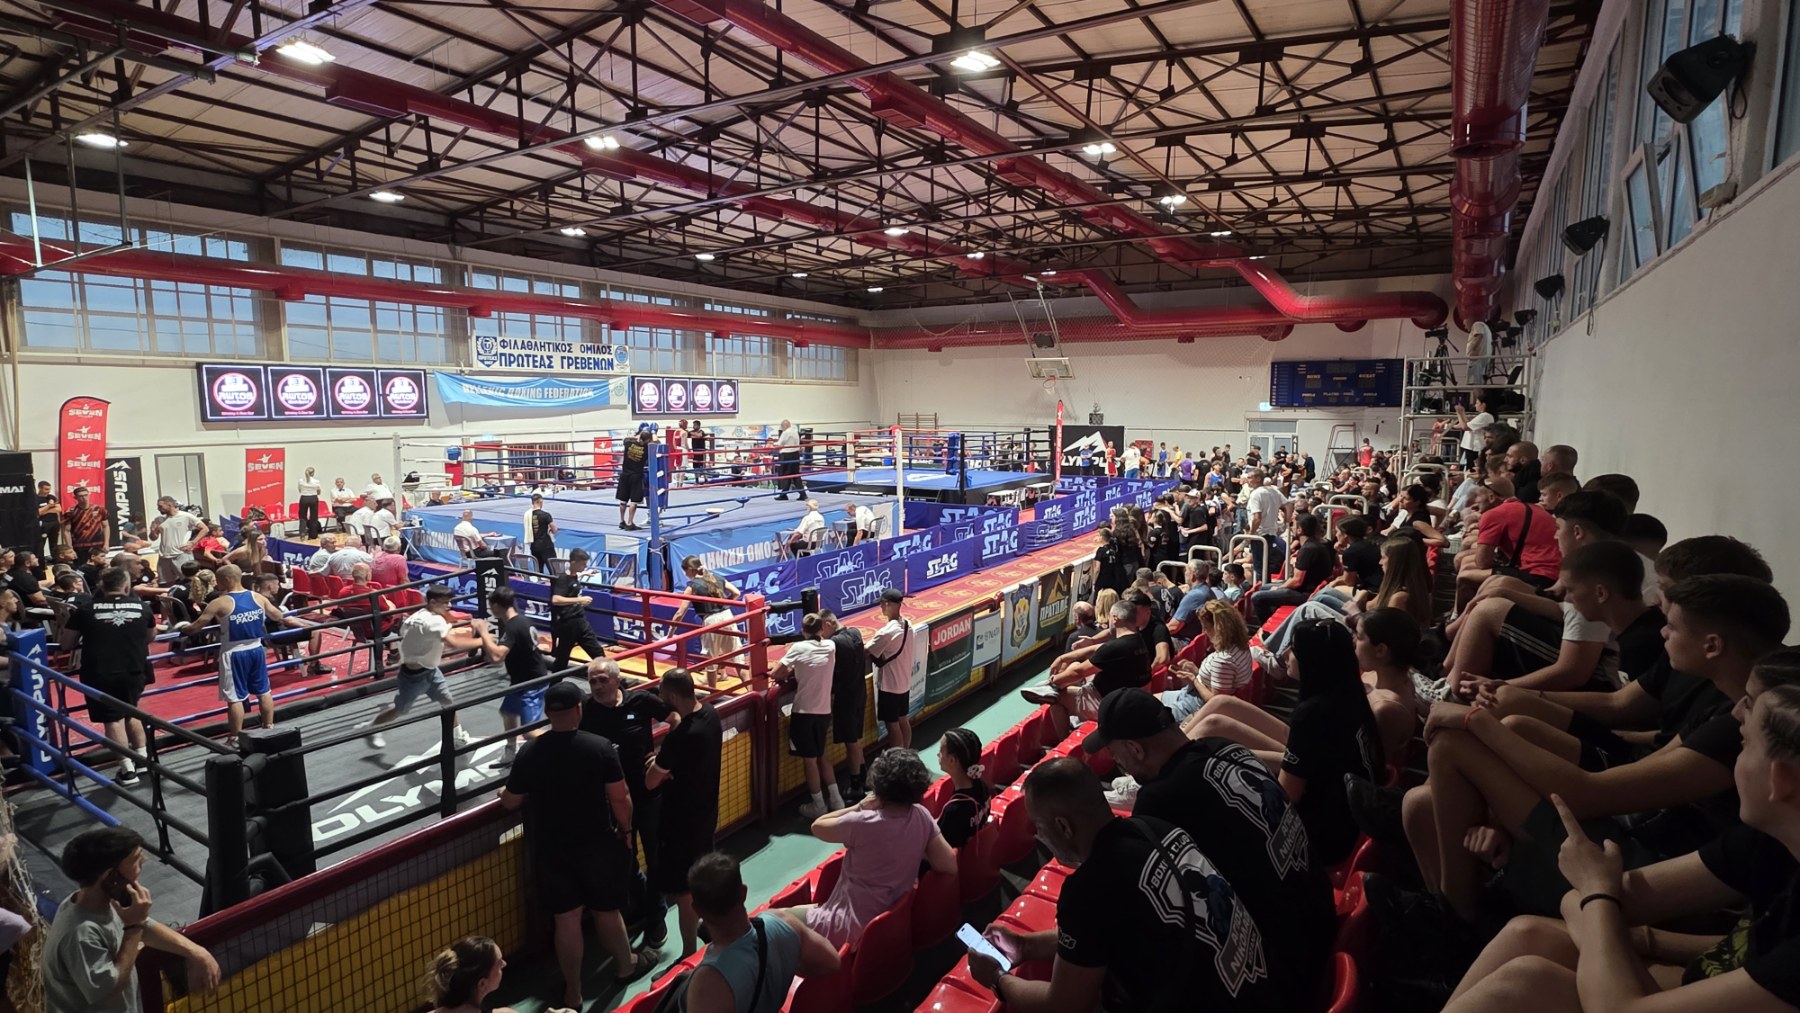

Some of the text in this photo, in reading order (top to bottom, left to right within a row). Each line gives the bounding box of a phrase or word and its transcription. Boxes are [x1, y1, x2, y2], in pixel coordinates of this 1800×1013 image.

[499, 338, 613, 355] ΦΙΛΑΘΛΗΤΙΚΟΣ ΟΜΙΛΟΣ
[499, 352, 614, 371] ΠΡΩΤΕΑΣ ΓΡΕΒΕΝΩΝ
[68, 408, 103, 416] SEVEN
[67, 431, 102, 440] SEVEN
[66, 460, 101, 468] SEVEN
[247, 461, 284, 472] SEVEN
[982, 528, 1020, 559] STAG
[927, 551, 959, 579] STAG
[841, 568, 893, 611] STAG
[230, 608, 264, 621] BOXING
[236, 614, 260, 625] PAOK
[933, 617, 972, 646] JORDAN
[1171, 834, 1191, 851] CLUB
